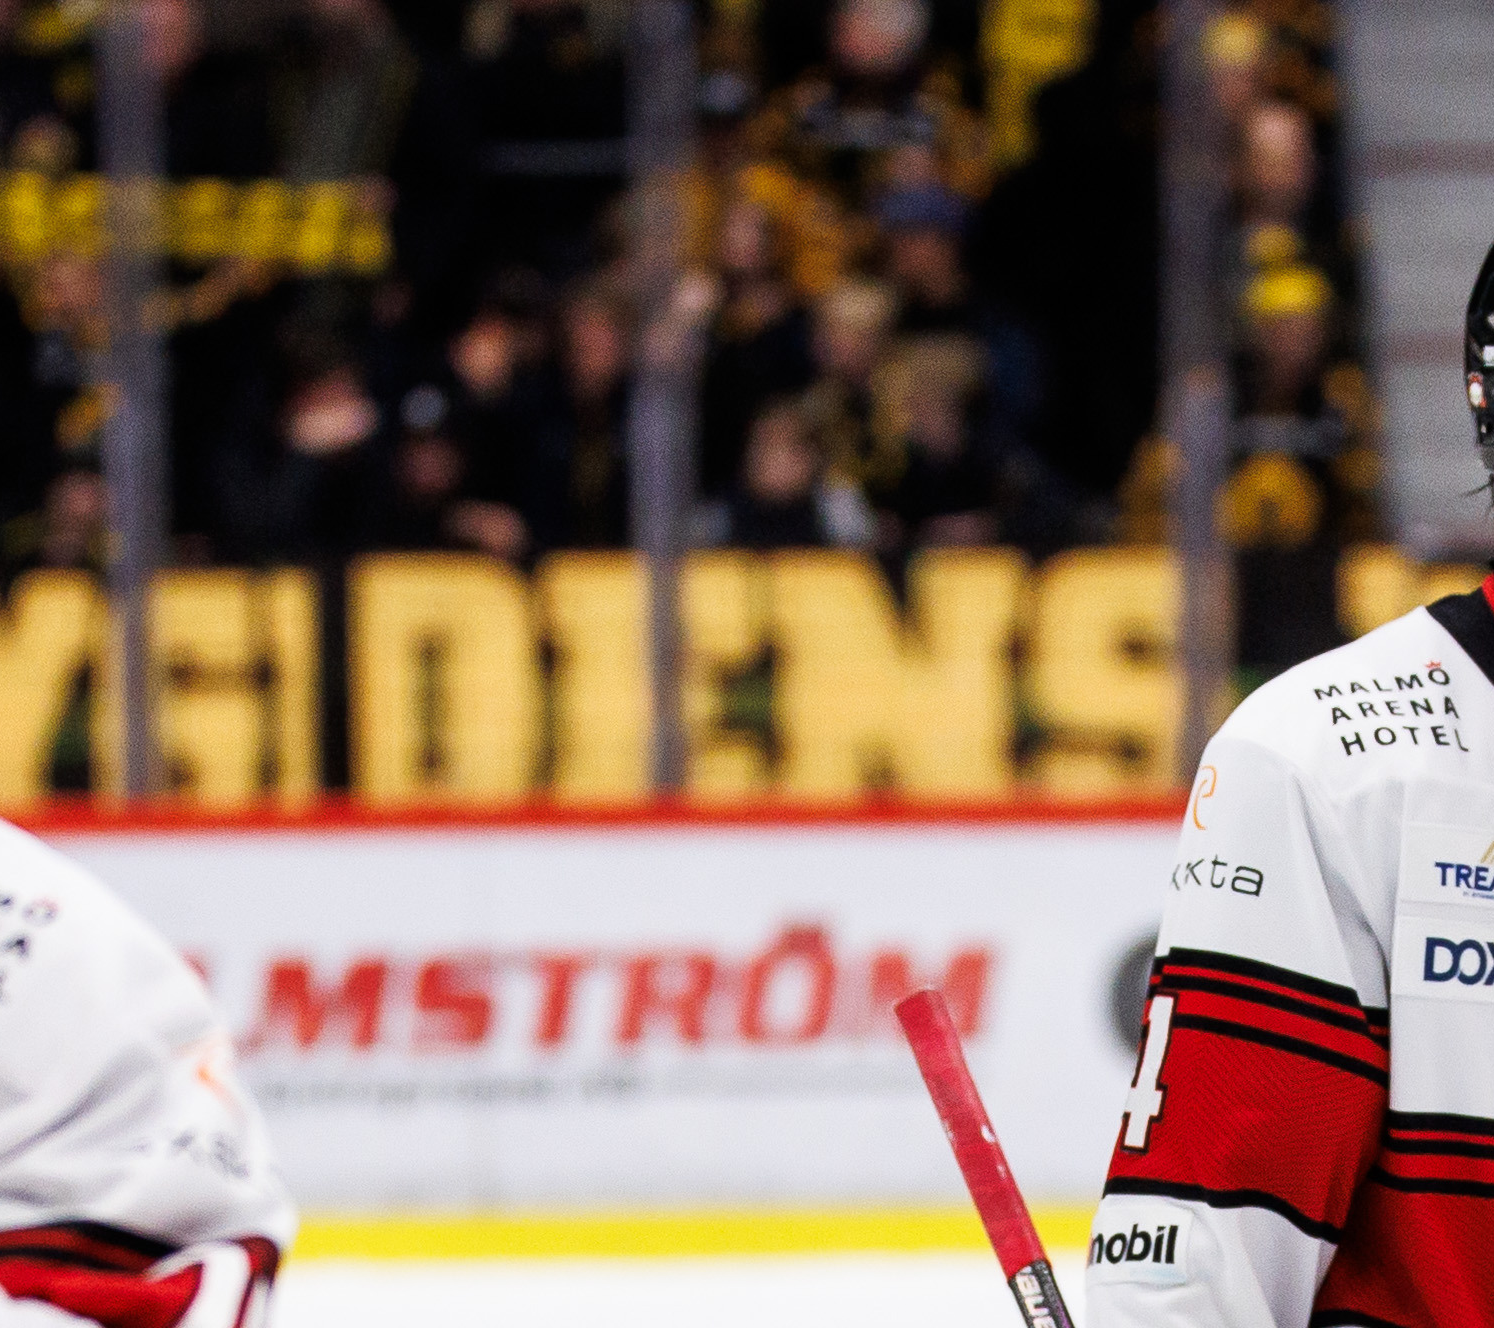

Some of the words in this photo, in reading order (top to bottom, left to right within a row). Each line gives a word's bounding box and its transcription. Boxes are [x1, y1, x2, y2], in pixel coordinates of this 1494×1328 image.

[1314, 660, 1451, 700] MALMÖ
[1331, 697, 1460, 725] ARENA
[1339, 725, 1469, 756] HOTEL
[239, 912, 996, 1056] MSTRÖM
